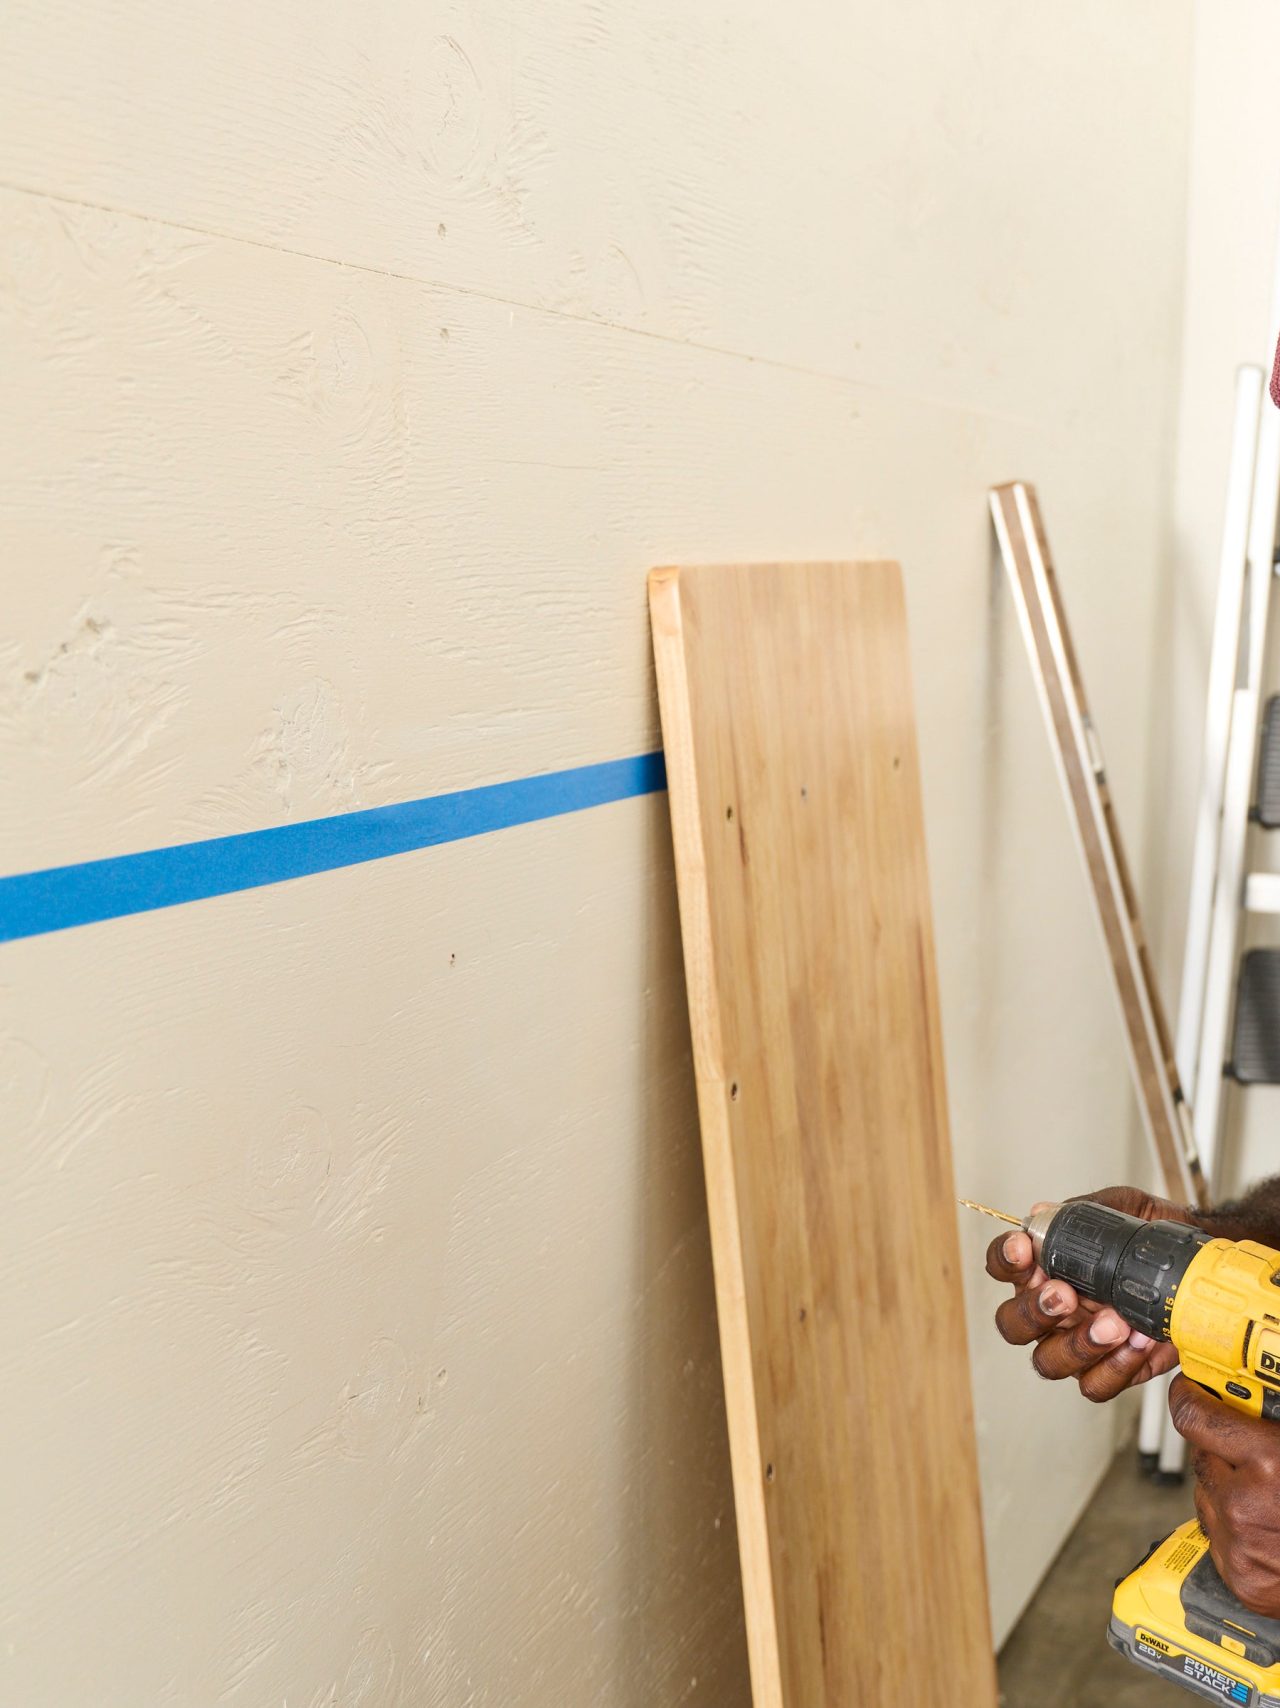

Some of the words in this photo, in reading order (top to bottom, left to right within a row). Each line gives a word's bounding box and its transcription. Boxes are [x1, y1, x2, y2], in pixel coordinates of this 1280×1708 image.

[1164, 1296, 1174, 1311] 15
[1183, 1664, 1231, 1695] STACK
[1184, 1656, 1237, 1689] POWER
